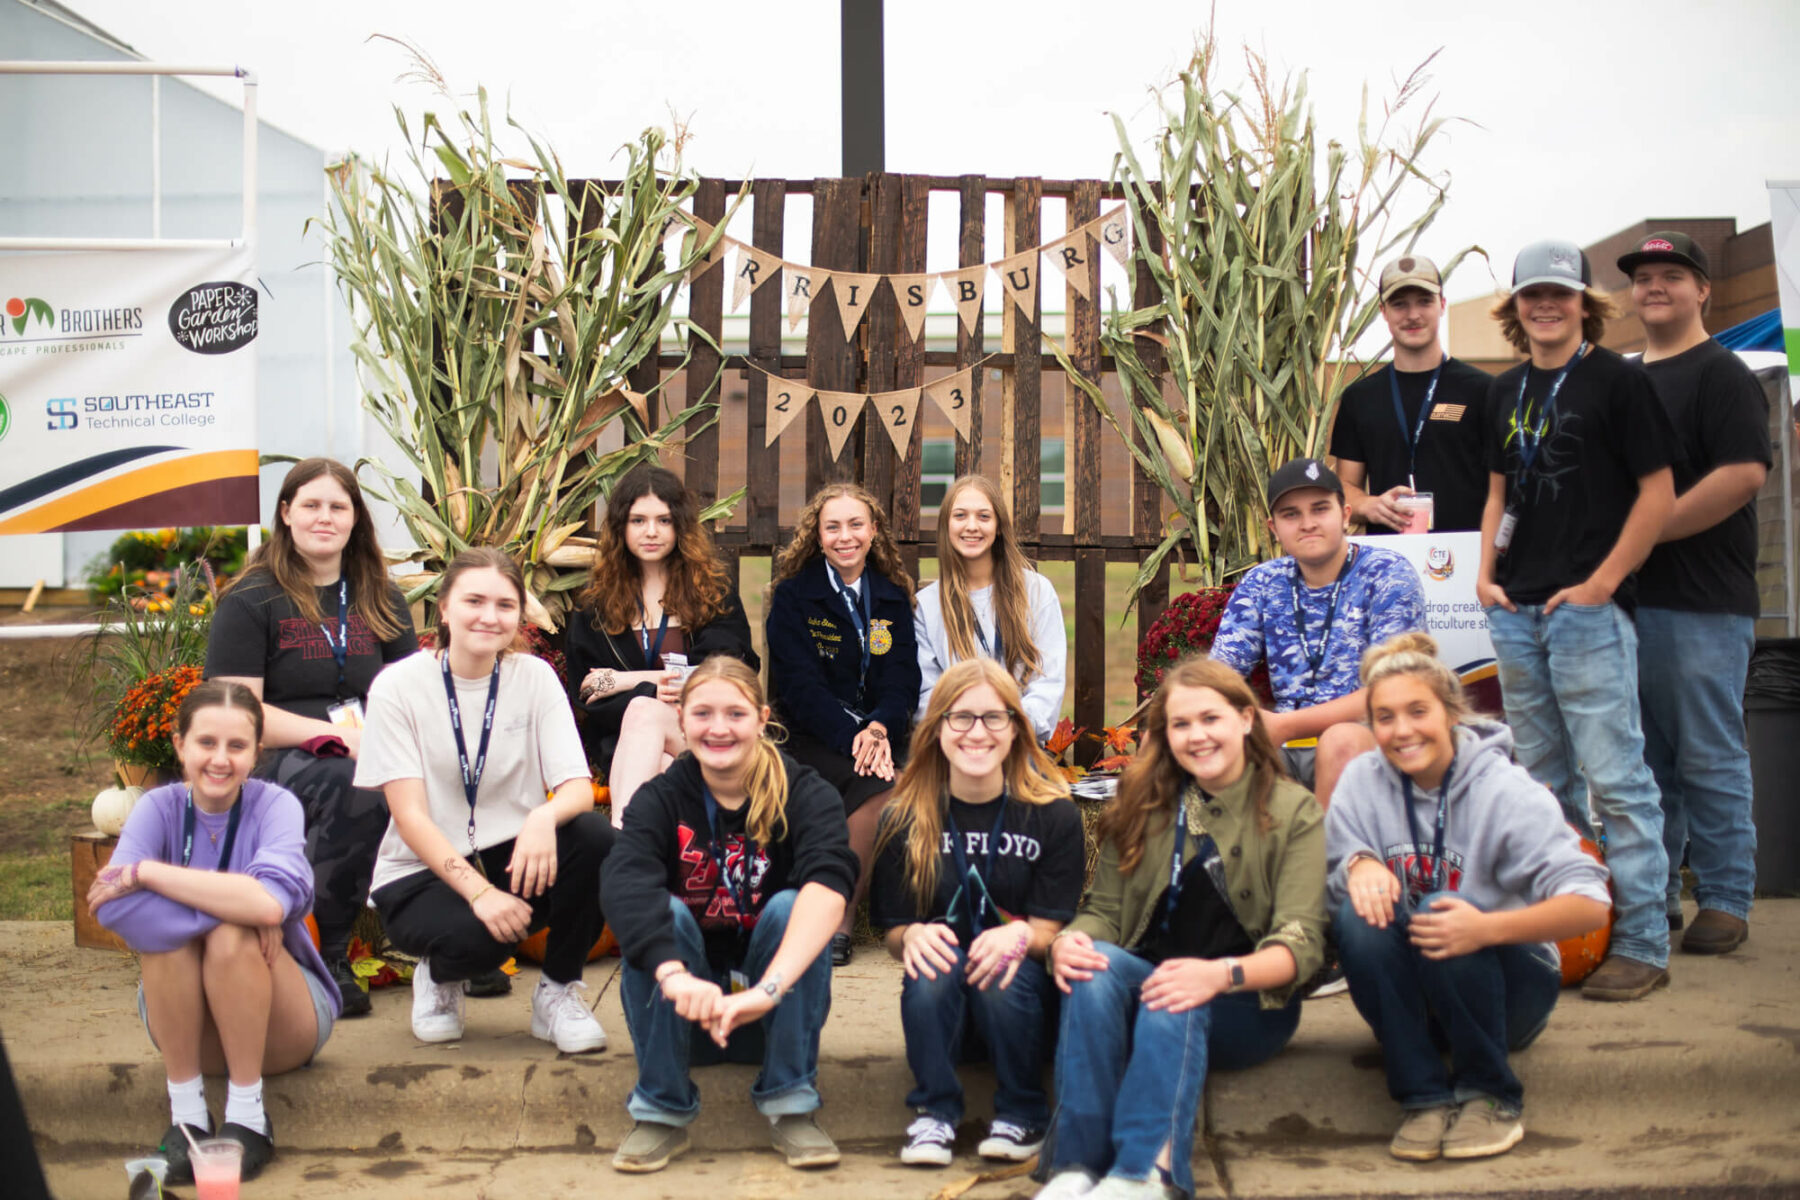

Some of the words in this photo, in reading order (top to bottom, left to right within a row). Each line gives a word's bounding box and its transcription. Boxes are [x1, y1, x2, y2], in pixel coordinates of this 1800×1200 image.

[190, 286, 236, 311] PAPER
[60, 307, 143, 333] BROTHERS
[178, 304, 255, 330] Garden
[36, 342, 125, 354] PROFESSIONALS
[84, 392, 215, 412] SOUTHEAST
[774, 388, 964, 427] 2023
[85, 415, 155, 429] Technical
[160, 413, 216, 428] College
[1432, 550, 1446, 559] CTE
